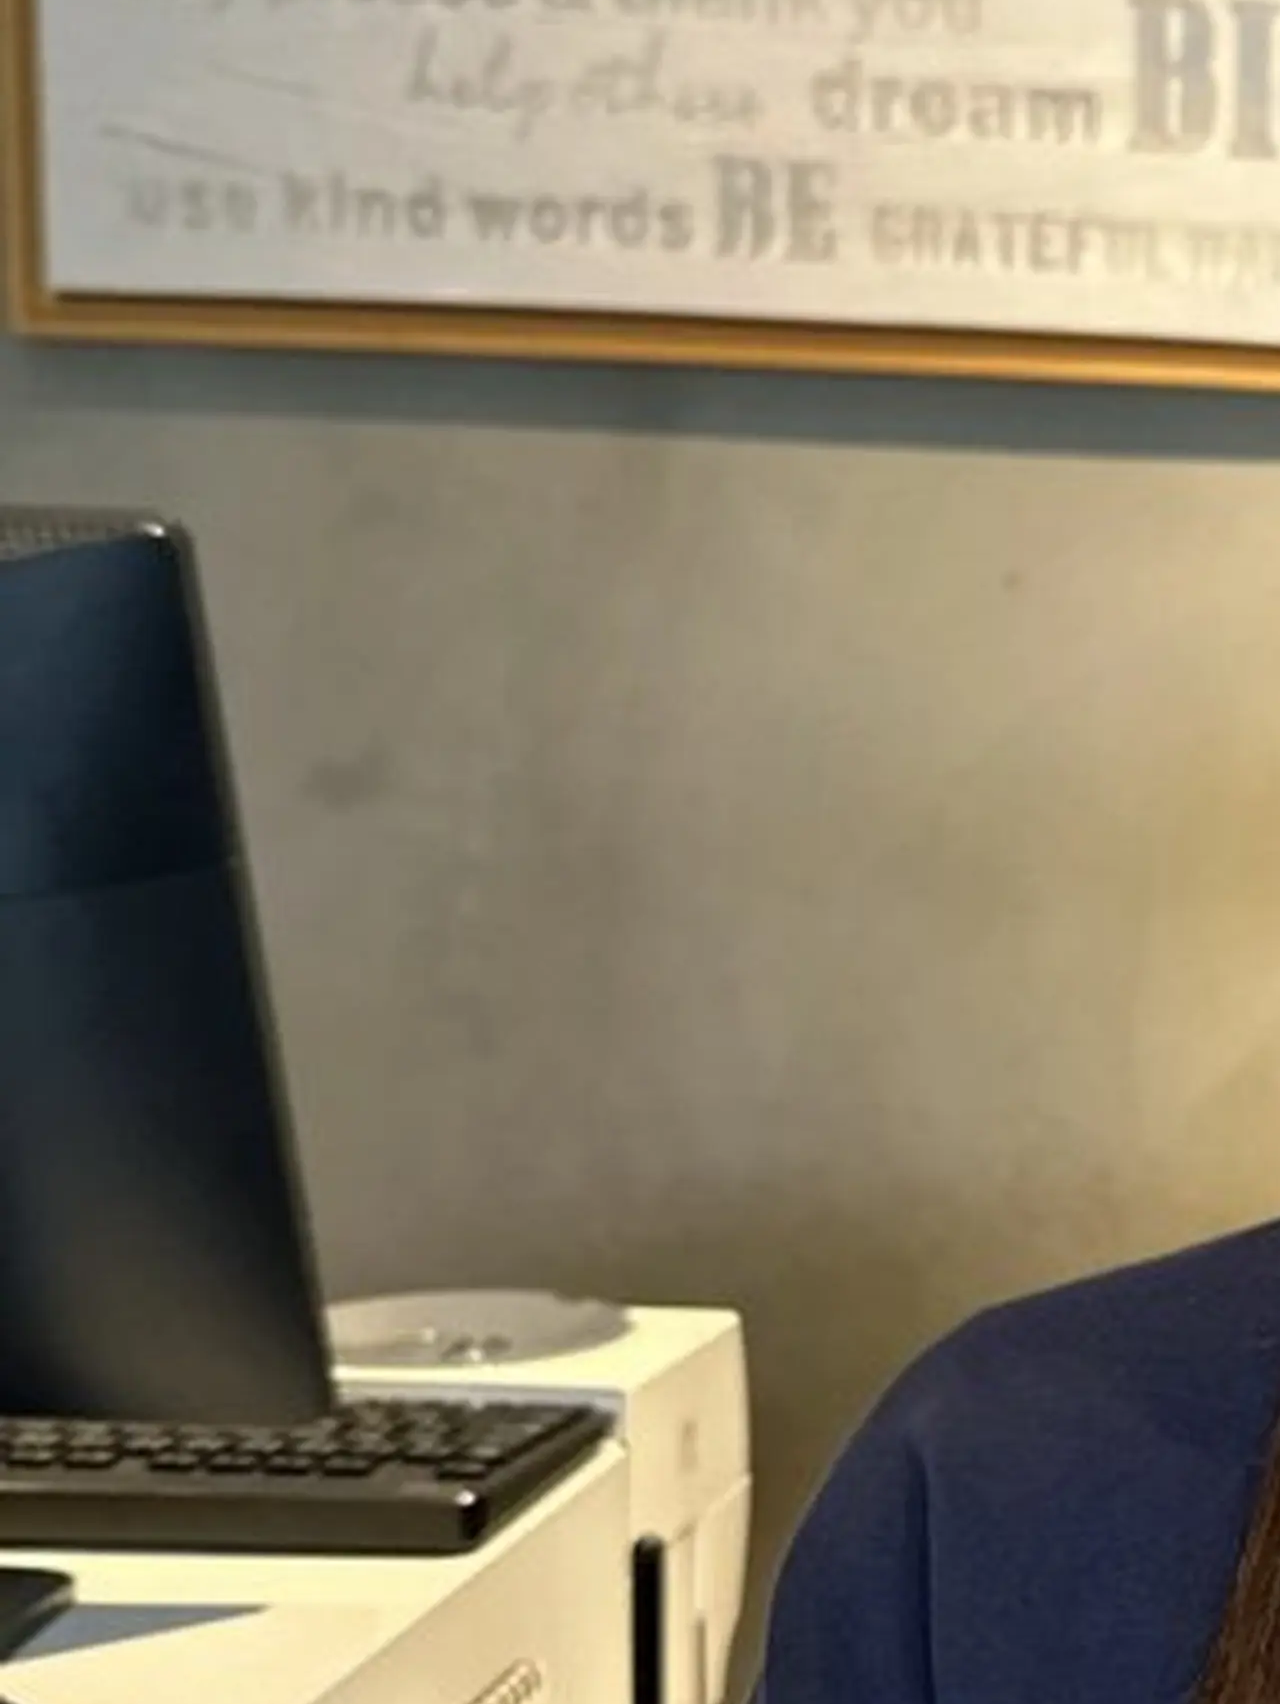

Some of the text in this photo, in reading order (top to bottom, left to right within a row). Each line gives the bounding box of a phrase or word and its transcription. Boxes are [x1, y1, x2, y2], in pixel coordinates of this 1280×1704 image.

[809, 58, 1103, 145] dream
[279, 169, 447, 242] kind
[466, 179, 694, 253] words
